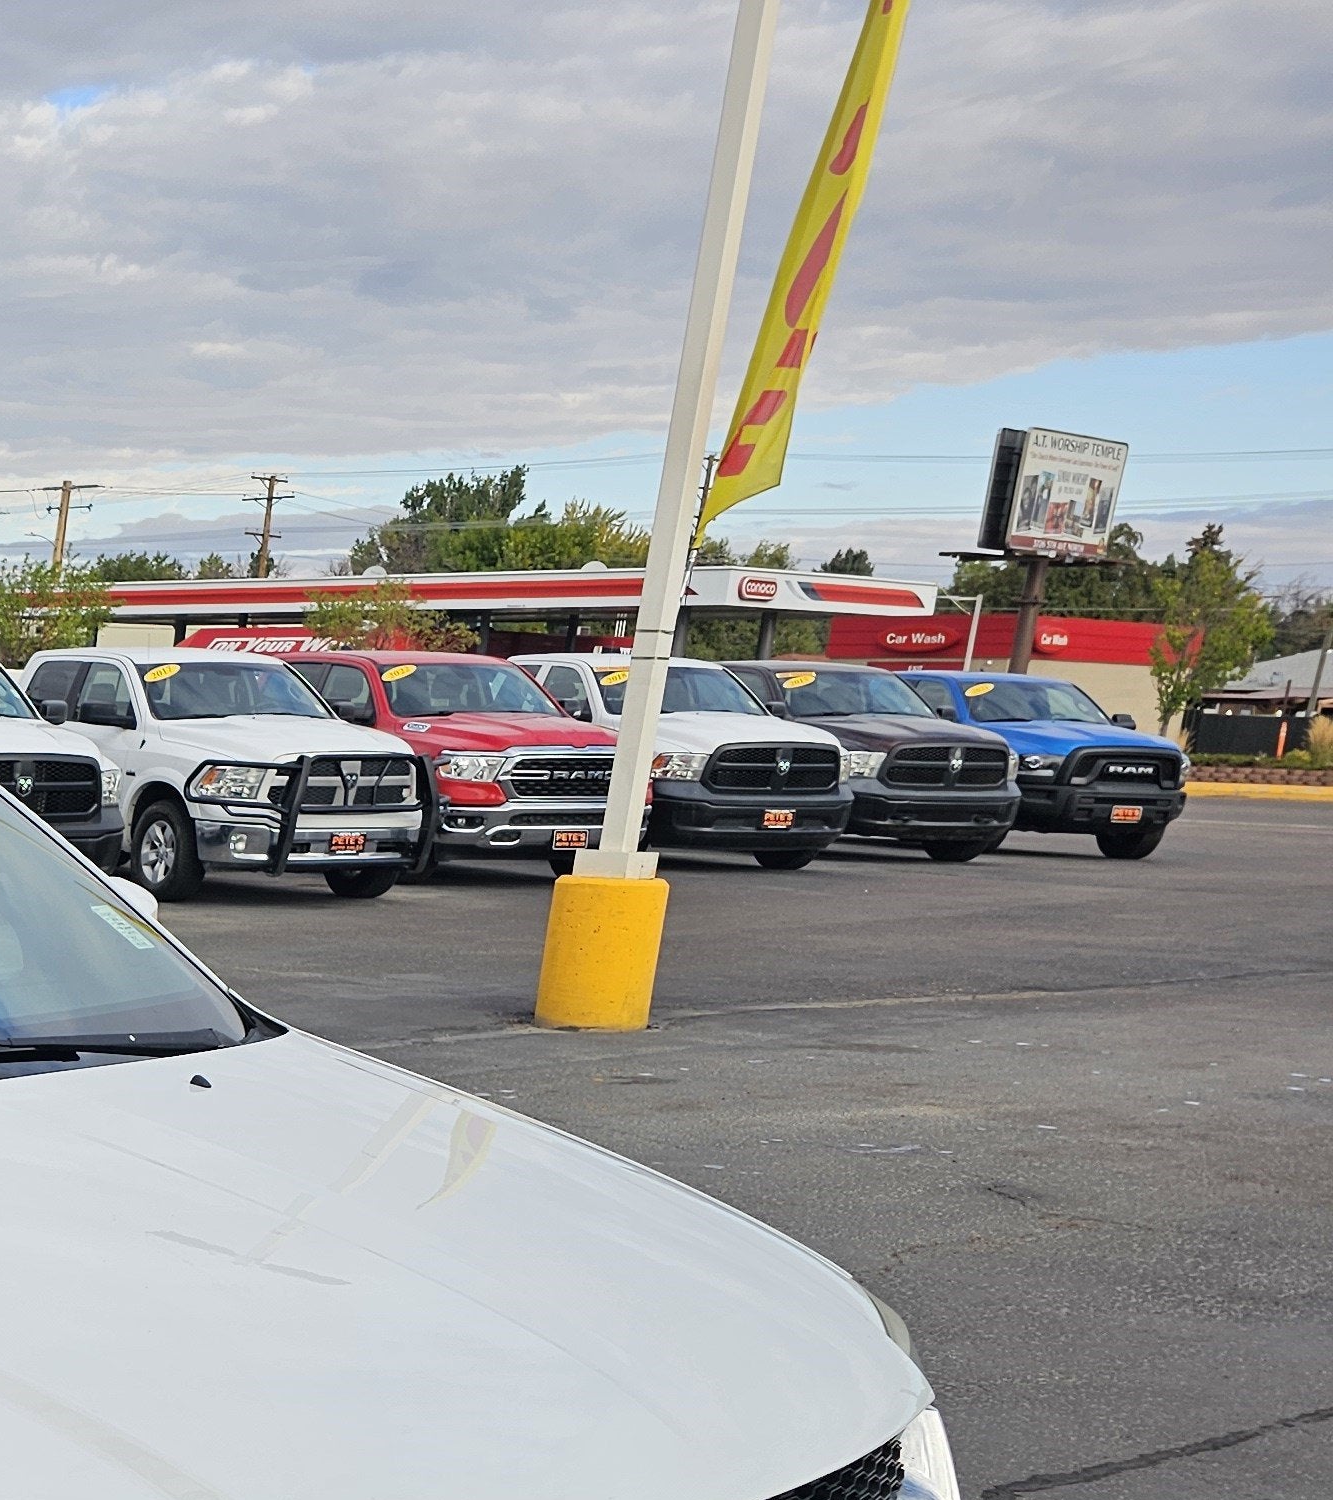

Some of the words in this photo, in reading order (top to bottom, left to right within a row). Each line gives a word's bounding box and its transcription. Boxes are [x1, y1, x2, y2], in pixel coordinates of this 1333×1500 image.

[1050, 436, 1090, 454] WORSHIP
[1091, 443, 1122, 461] TEMPLE
[886, 633, 908, 645] Car
[910, 633, 946, 645] Wash
[553, 770, 605, 780] RAM
[1109, 765, 1154, 774] RAM
